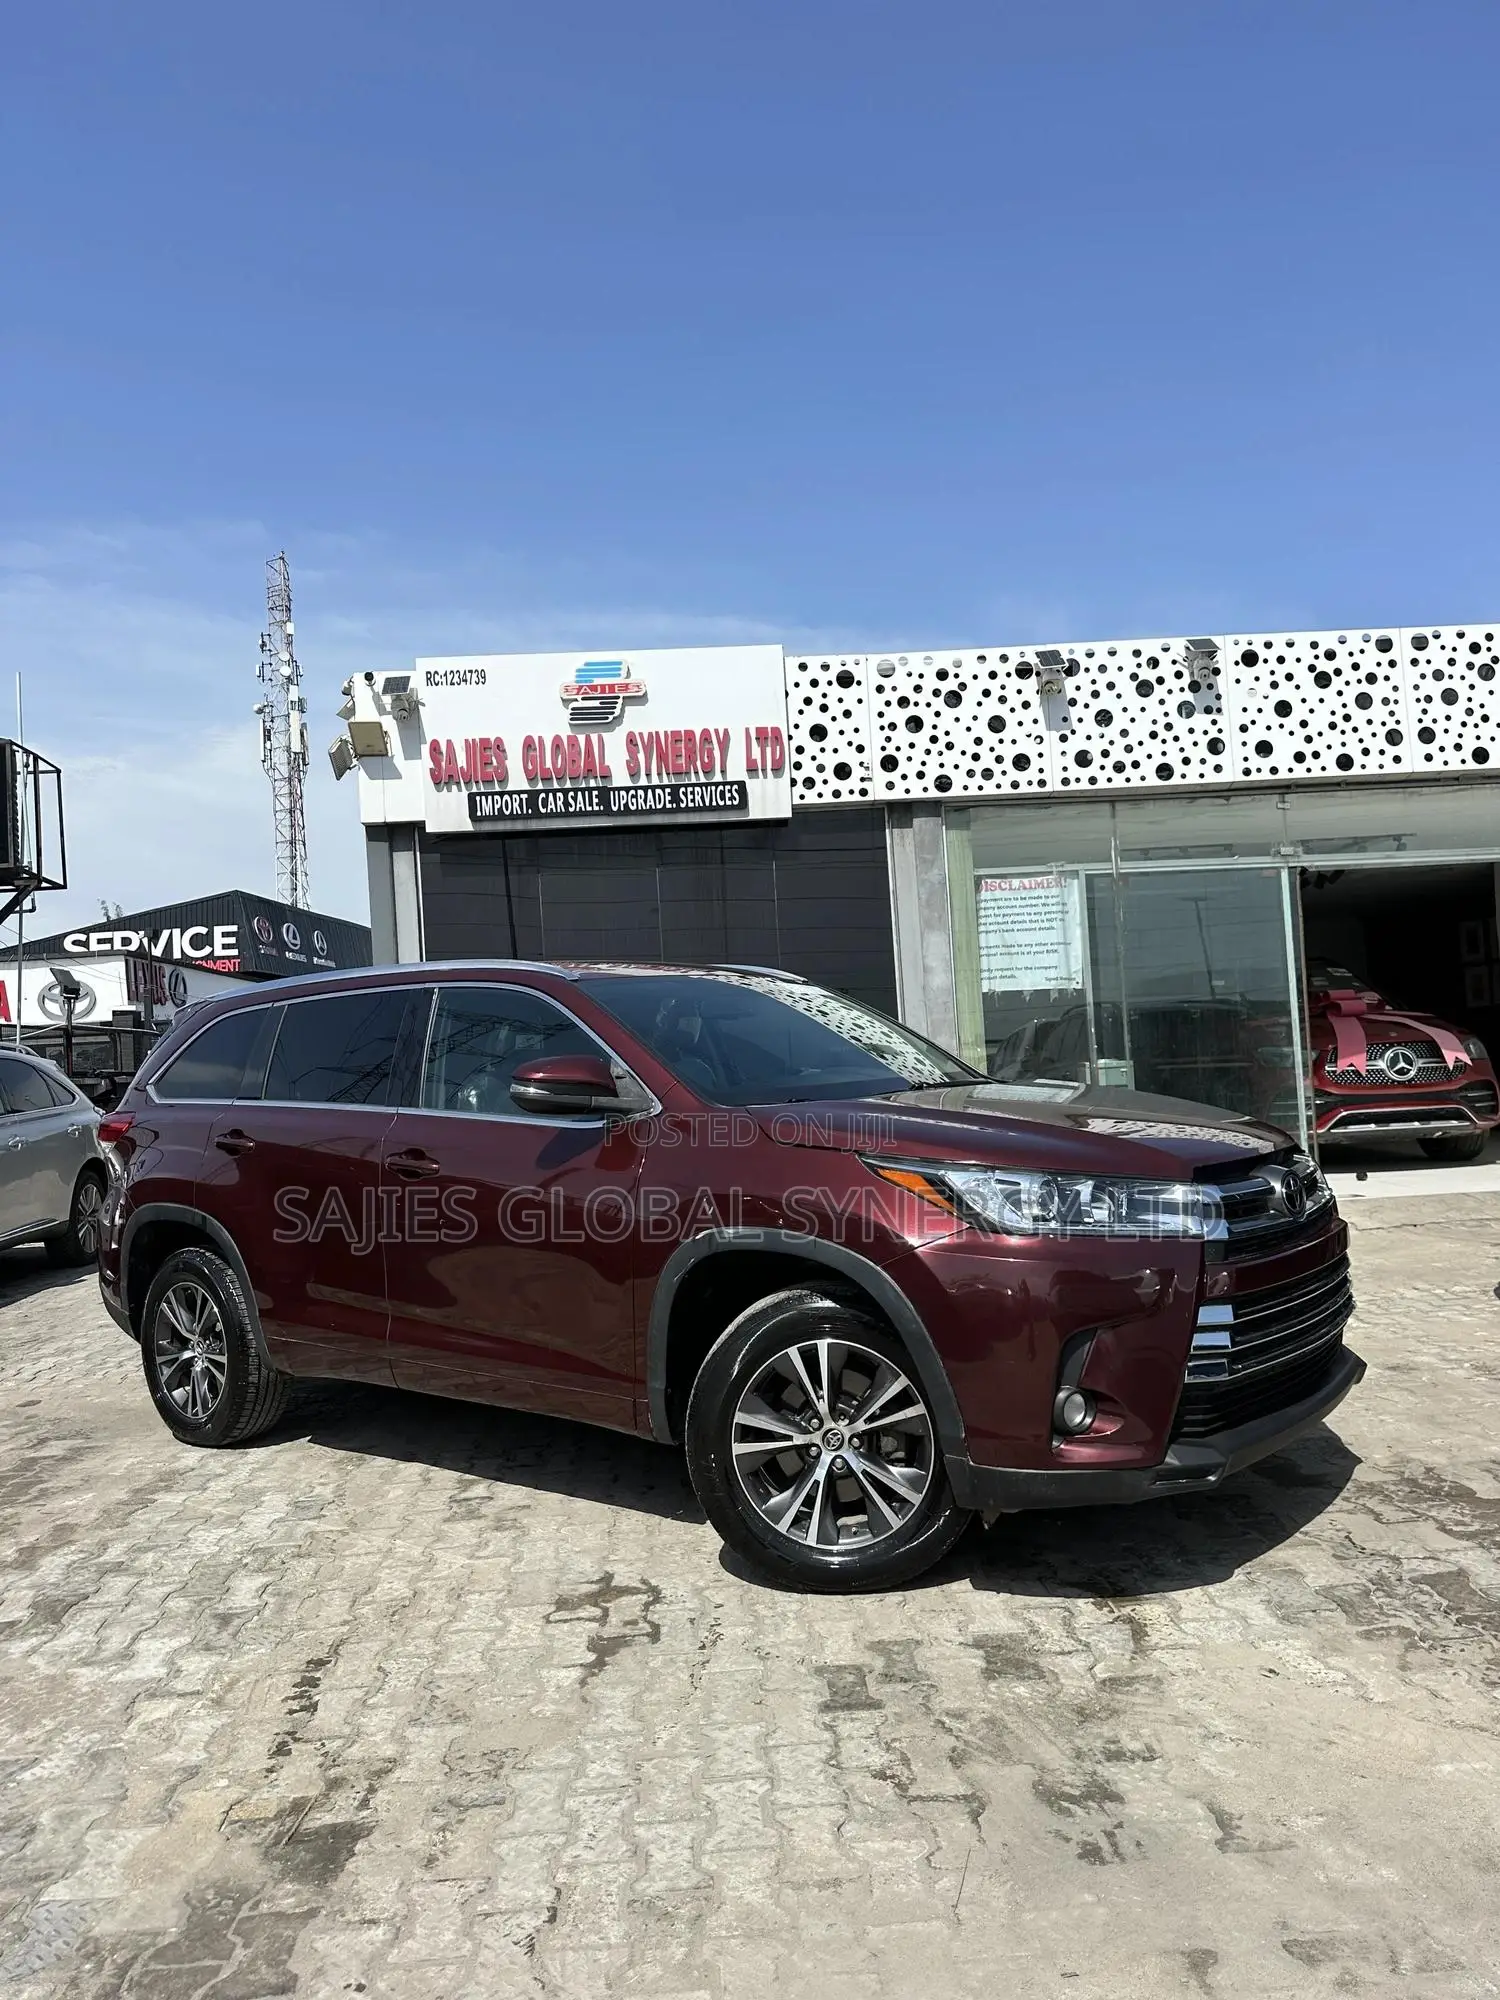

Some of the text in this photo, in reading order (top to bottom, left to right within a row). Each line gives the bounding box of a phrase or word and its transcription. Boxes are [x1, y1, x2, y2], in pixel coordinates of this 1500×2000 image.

[425, 668, 487, 687] RC:1234739
[562, 682, 644, 696] SAJIES
[429, 726, 785, 785] SAJIES GLOBAL SYNERGY LTD
[475, 784, 740, 817] IMPORT. CAR SALE. UPGRADE. SERVICES
[63, 924, 240, 959] SERVICE
